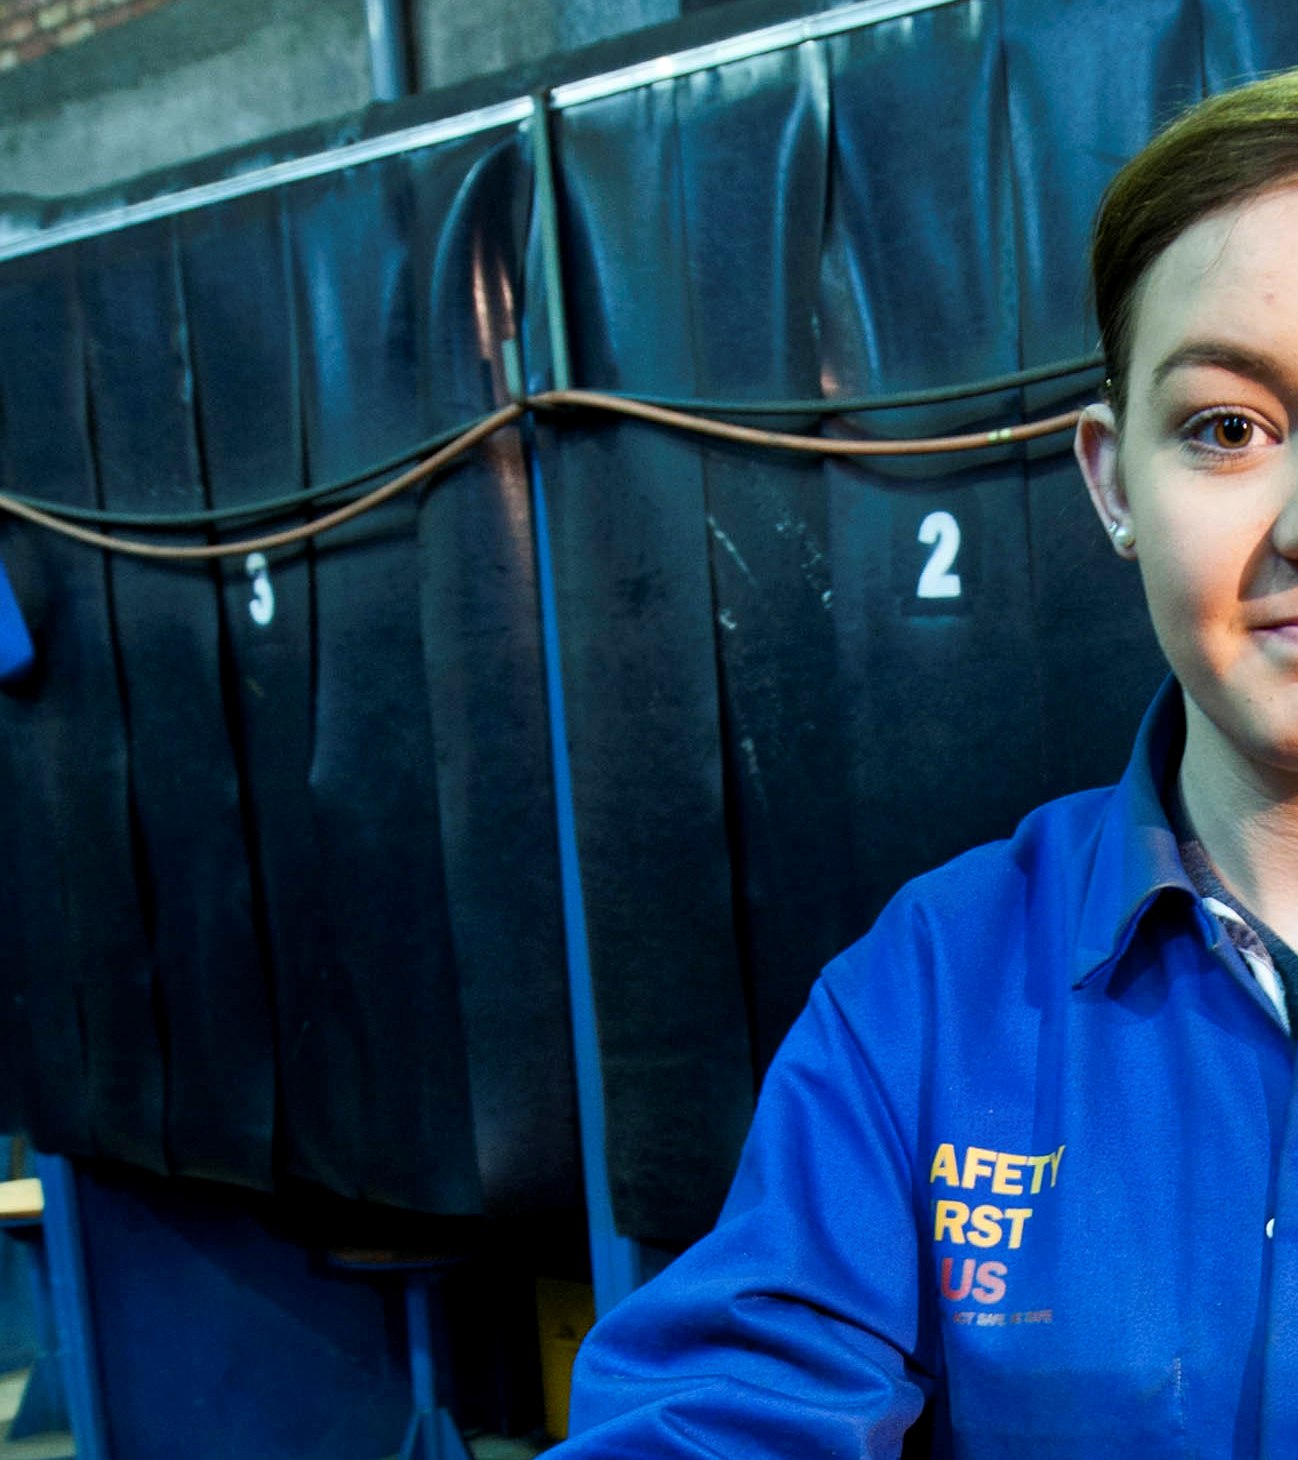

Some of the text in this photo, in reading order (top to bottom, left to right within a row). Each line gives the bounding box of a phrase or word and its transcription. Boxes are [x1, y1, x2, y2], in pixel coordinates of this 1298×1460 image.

[245, 552, 275, 627] 3
[917, 510, 961, 598] 2
[940, 1257, 1008, 1305] US
